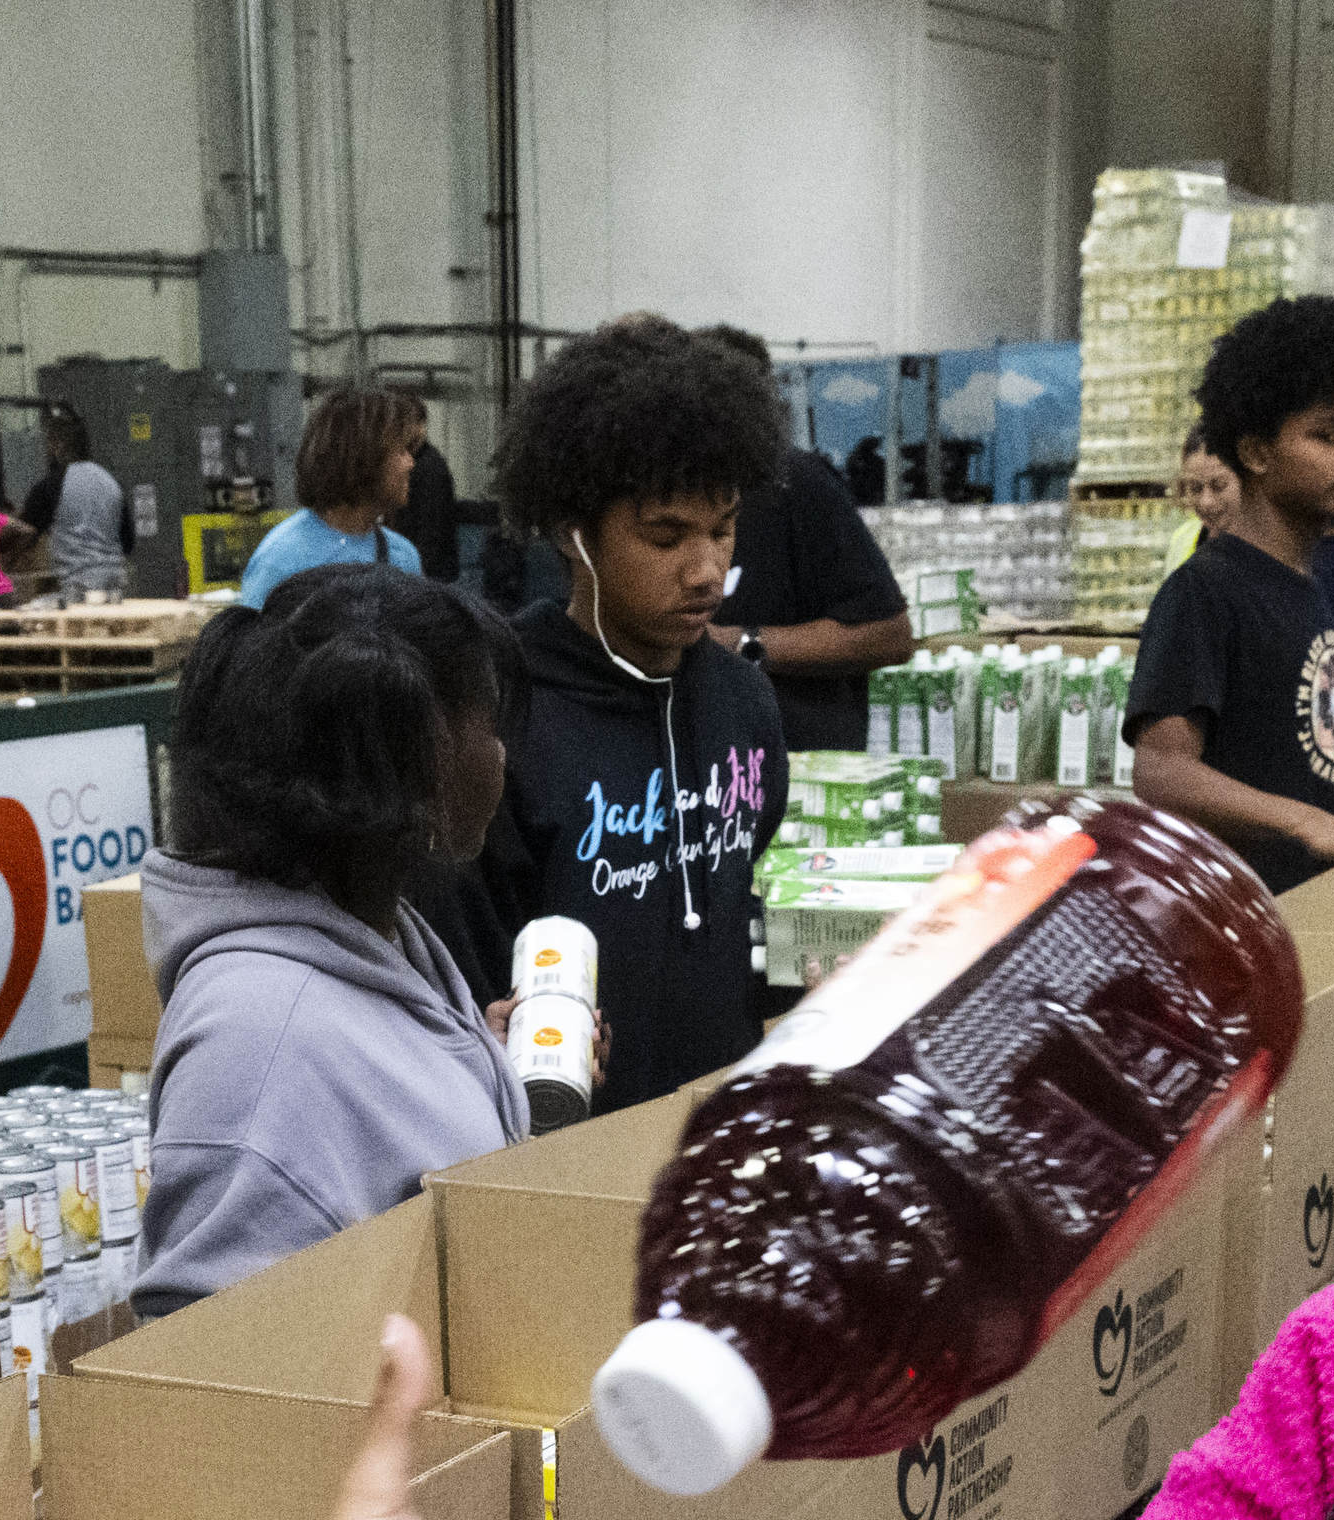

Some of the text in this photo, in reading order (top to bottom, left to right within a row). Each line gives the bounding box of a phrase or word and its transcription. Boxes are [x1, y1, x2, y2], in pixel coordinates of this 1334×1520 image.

[46, 783, 100, 830] OC
[576, 767, 666, 861] Jack
[721, 746, 765, 818] Jill
[51, 825, 147, 877] FOOD
[592, 858, 659, 900] Orange
[950, 1393, 1010, 1457] COMMUNITY
[949, 1440, 985, 1491] ACTION
